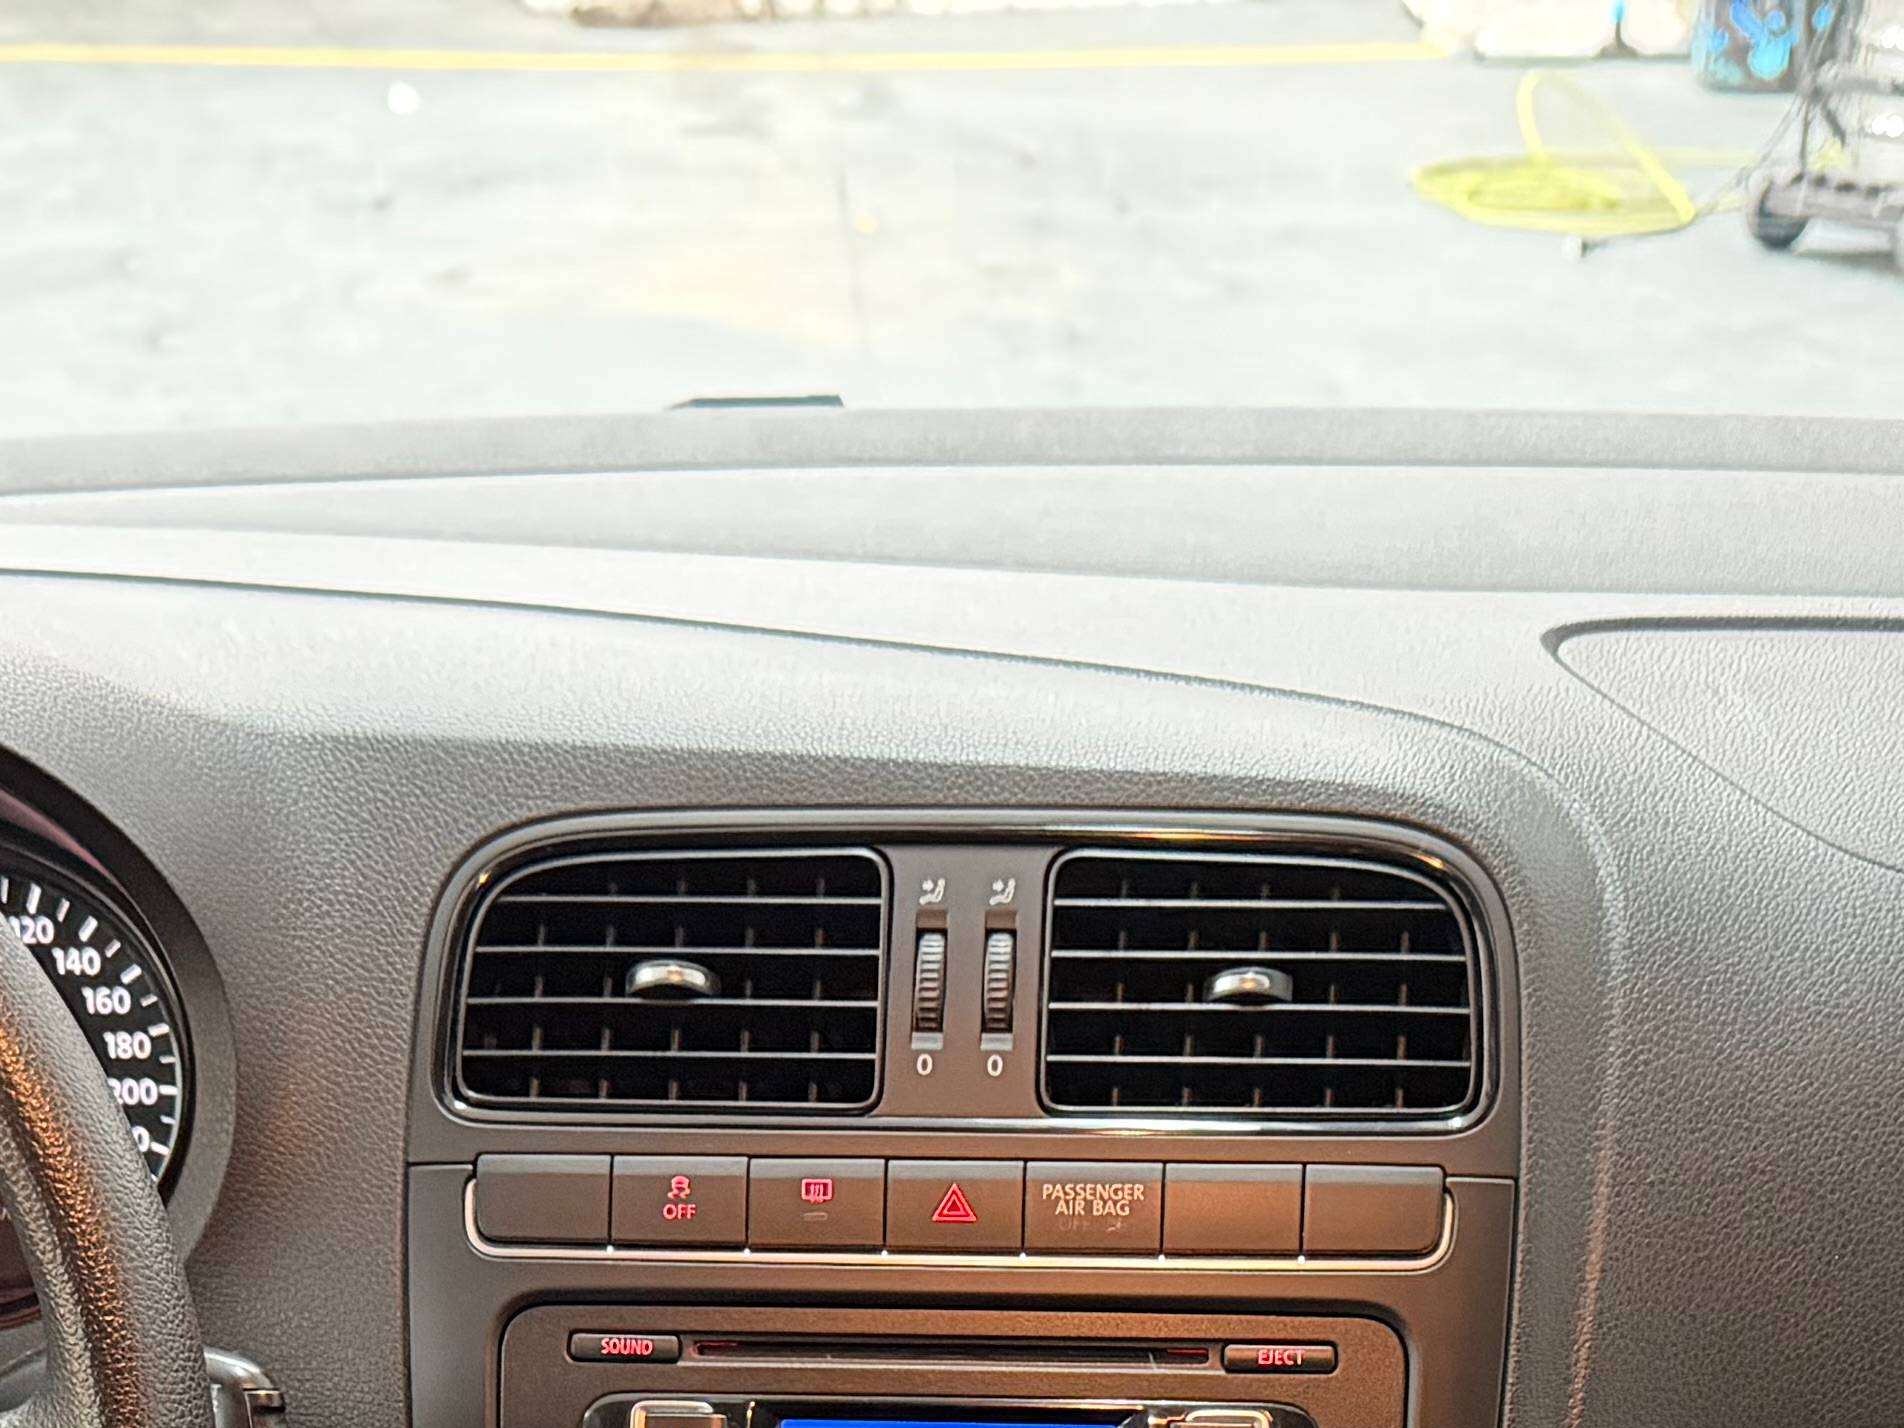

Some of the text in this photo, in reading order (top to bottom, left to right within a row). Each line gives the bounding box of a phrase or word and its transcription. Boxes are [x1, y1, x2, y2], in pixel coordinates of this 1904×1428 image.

[51, 946, 102, 977] 140
[81, 985, 132, 1015] 160
[103, 1030, 152, 1060] 180
[916, 1053, 933, 1076] 0
[987, 1054, 1003, 1077] 0
[1042, 1183, 1145, 1201] PASSENGER
[662, 1203, 697, 1220] OFF
[1055, 1200, 1130, 1217] AIR BAG
[600, 1338, 653, 1355] SOUND
[1257, 1349, 1306, 1366] EJECT
